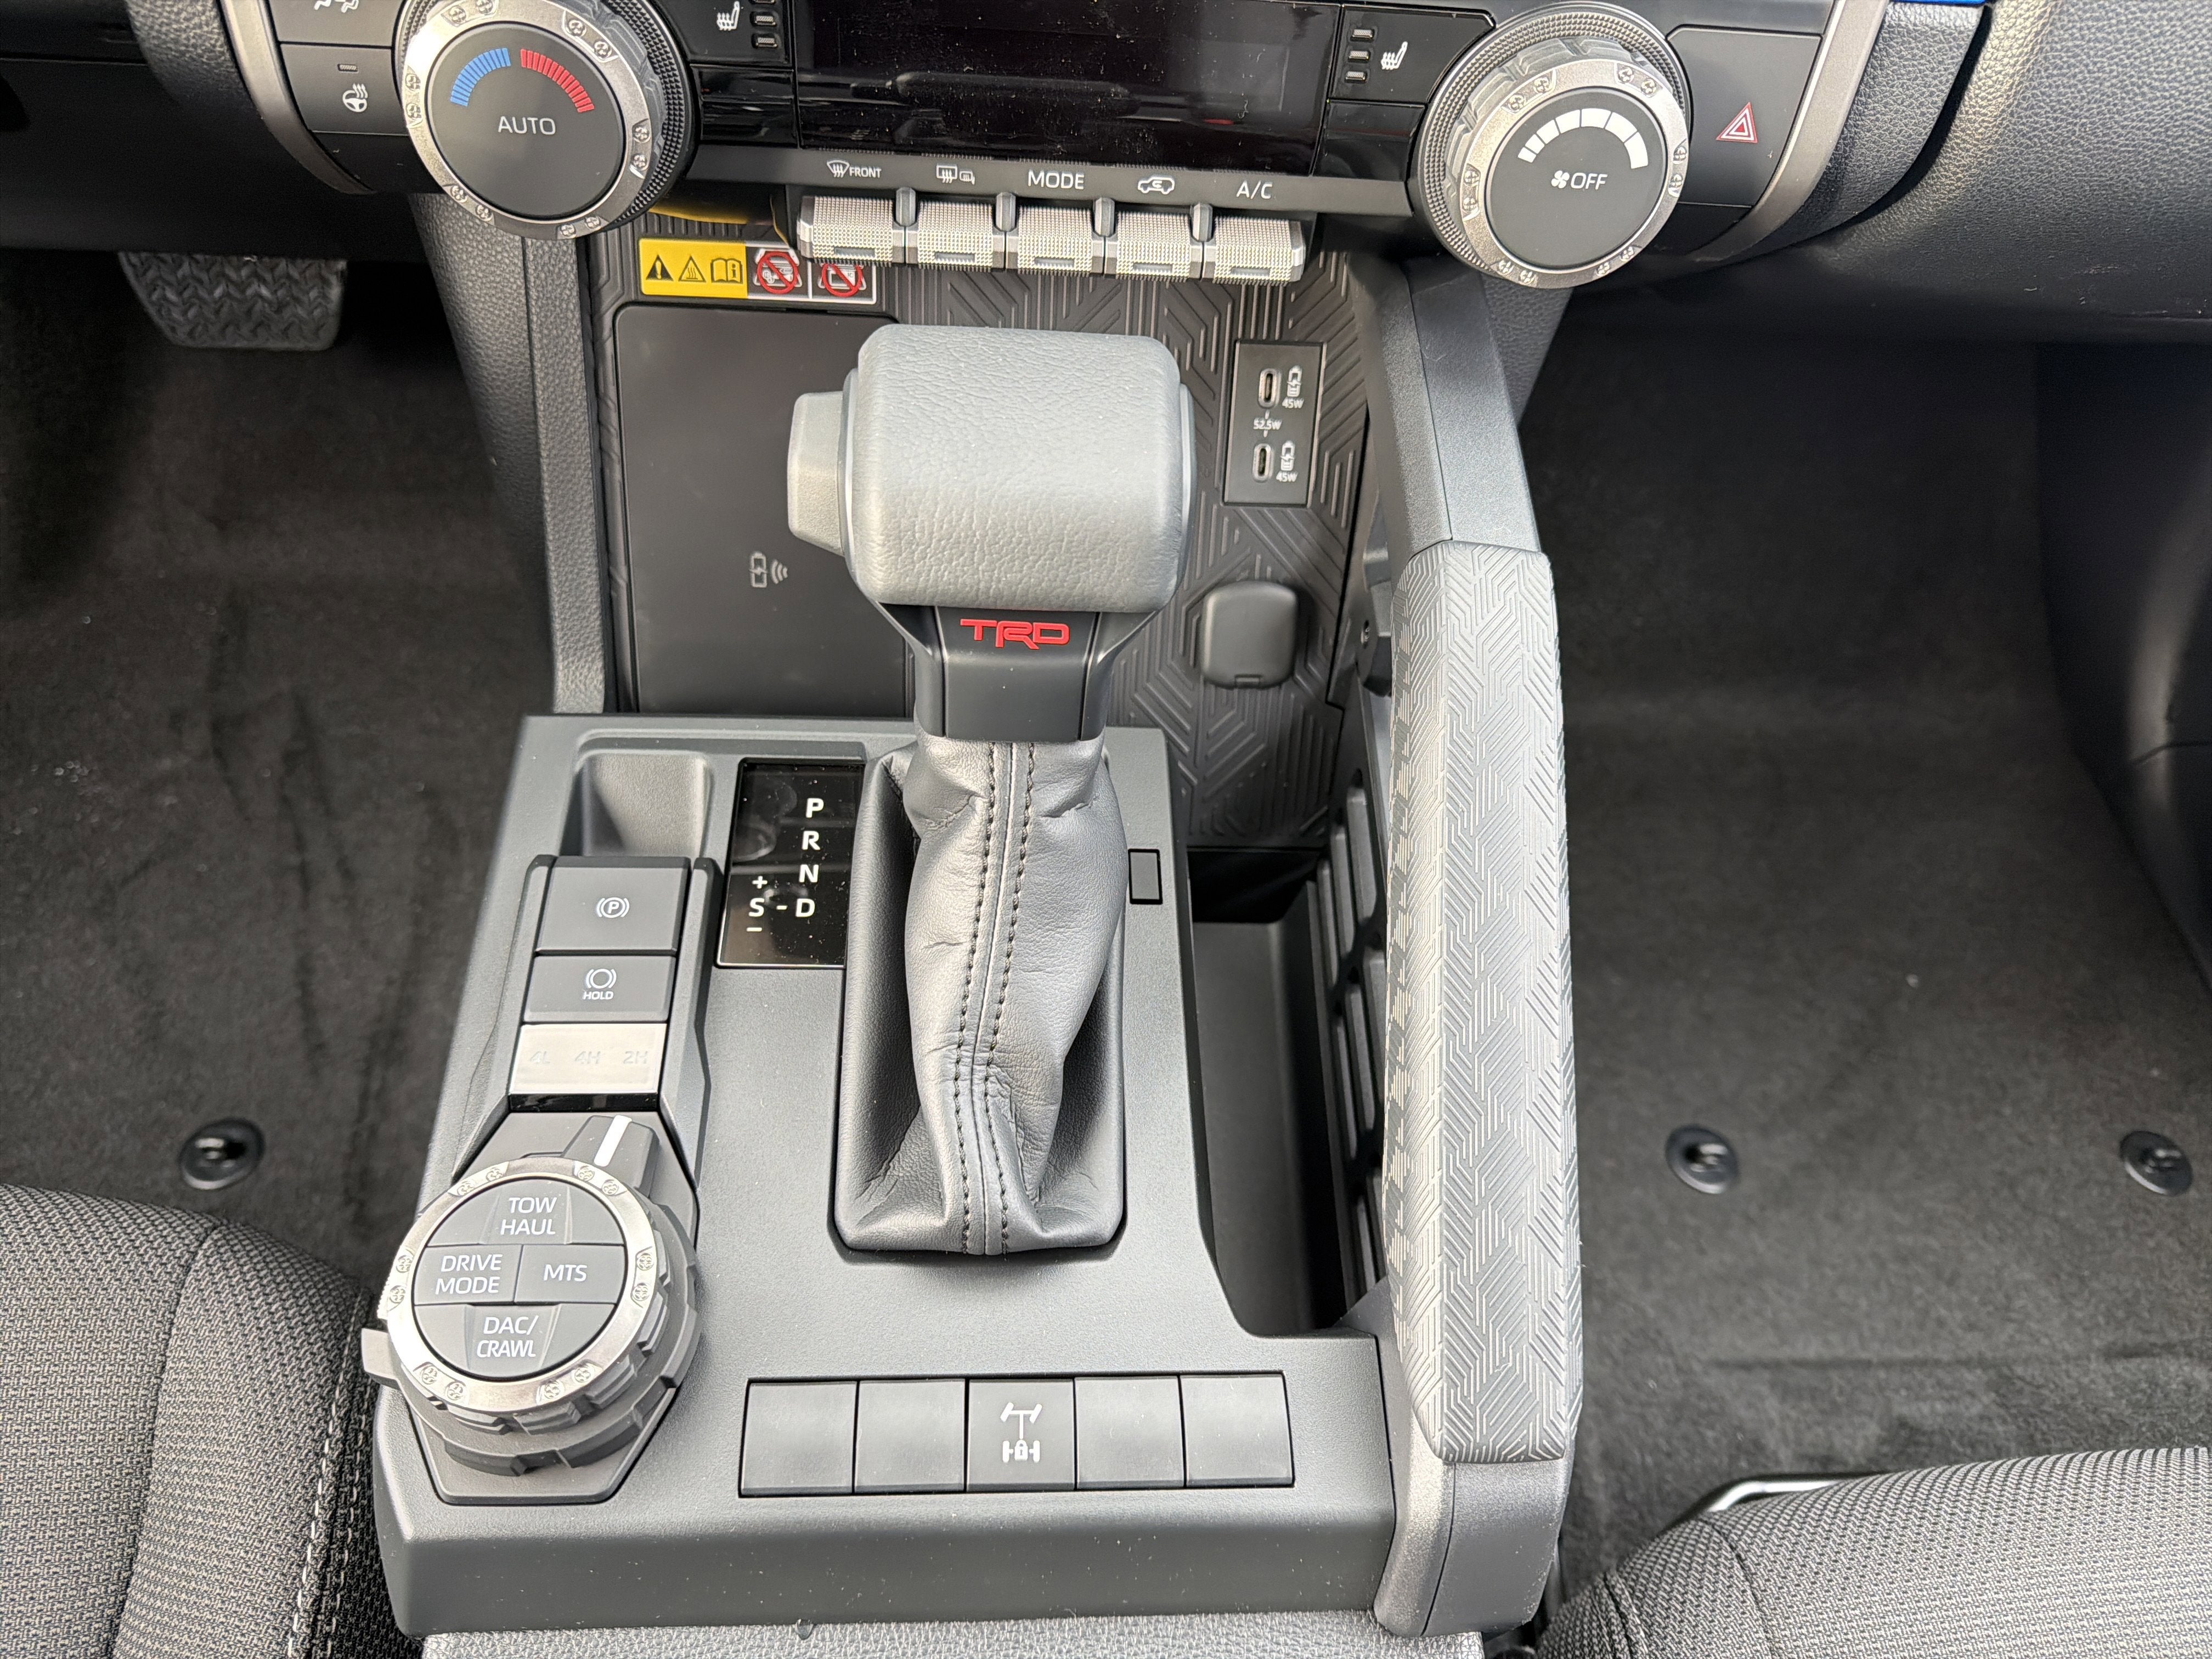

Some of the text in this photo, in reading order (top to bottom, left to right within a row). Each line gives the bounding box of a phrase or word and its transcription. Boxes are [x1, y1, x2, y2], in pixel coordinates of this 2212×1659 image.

[498, 116, 556, 136] AUTO
[849, 166, 882, 178] FRONT
[1028, 170, 1085, 190] MODE
[1571, 172, 1608, 190] OFF
[1236, 181, 1272, 199] A/C
[1282, 397, 1304, 409] 45W
[1253, 417, 1282, 431] 52.5W
[1276, 472, 1298, 482] 45W
[960, 619, 1070, 650] TRD
[805, 798, 824, 818] P
[802, 831, 821, 850] R
[799, 864, 819, 883] N
[748, 898, 765, 918] S
[795, 899, 815, 917] D
[584, 991, 614, 1000] HOLD
[529, 1051, 648, 1064] 4L 4H 2H
[508, 1197, 557, 1213] TOW
[500, 1219, 556, 1235] HAUL
[440, 1254, 503, 1272] DRIVE
[543, 1265, 588, 1282] MTS
[436, 1277, 500, 1294] MODE
[483, 1316, 539, 1334] DAC/
[476, 1340, 537, 1357] CRAWL
